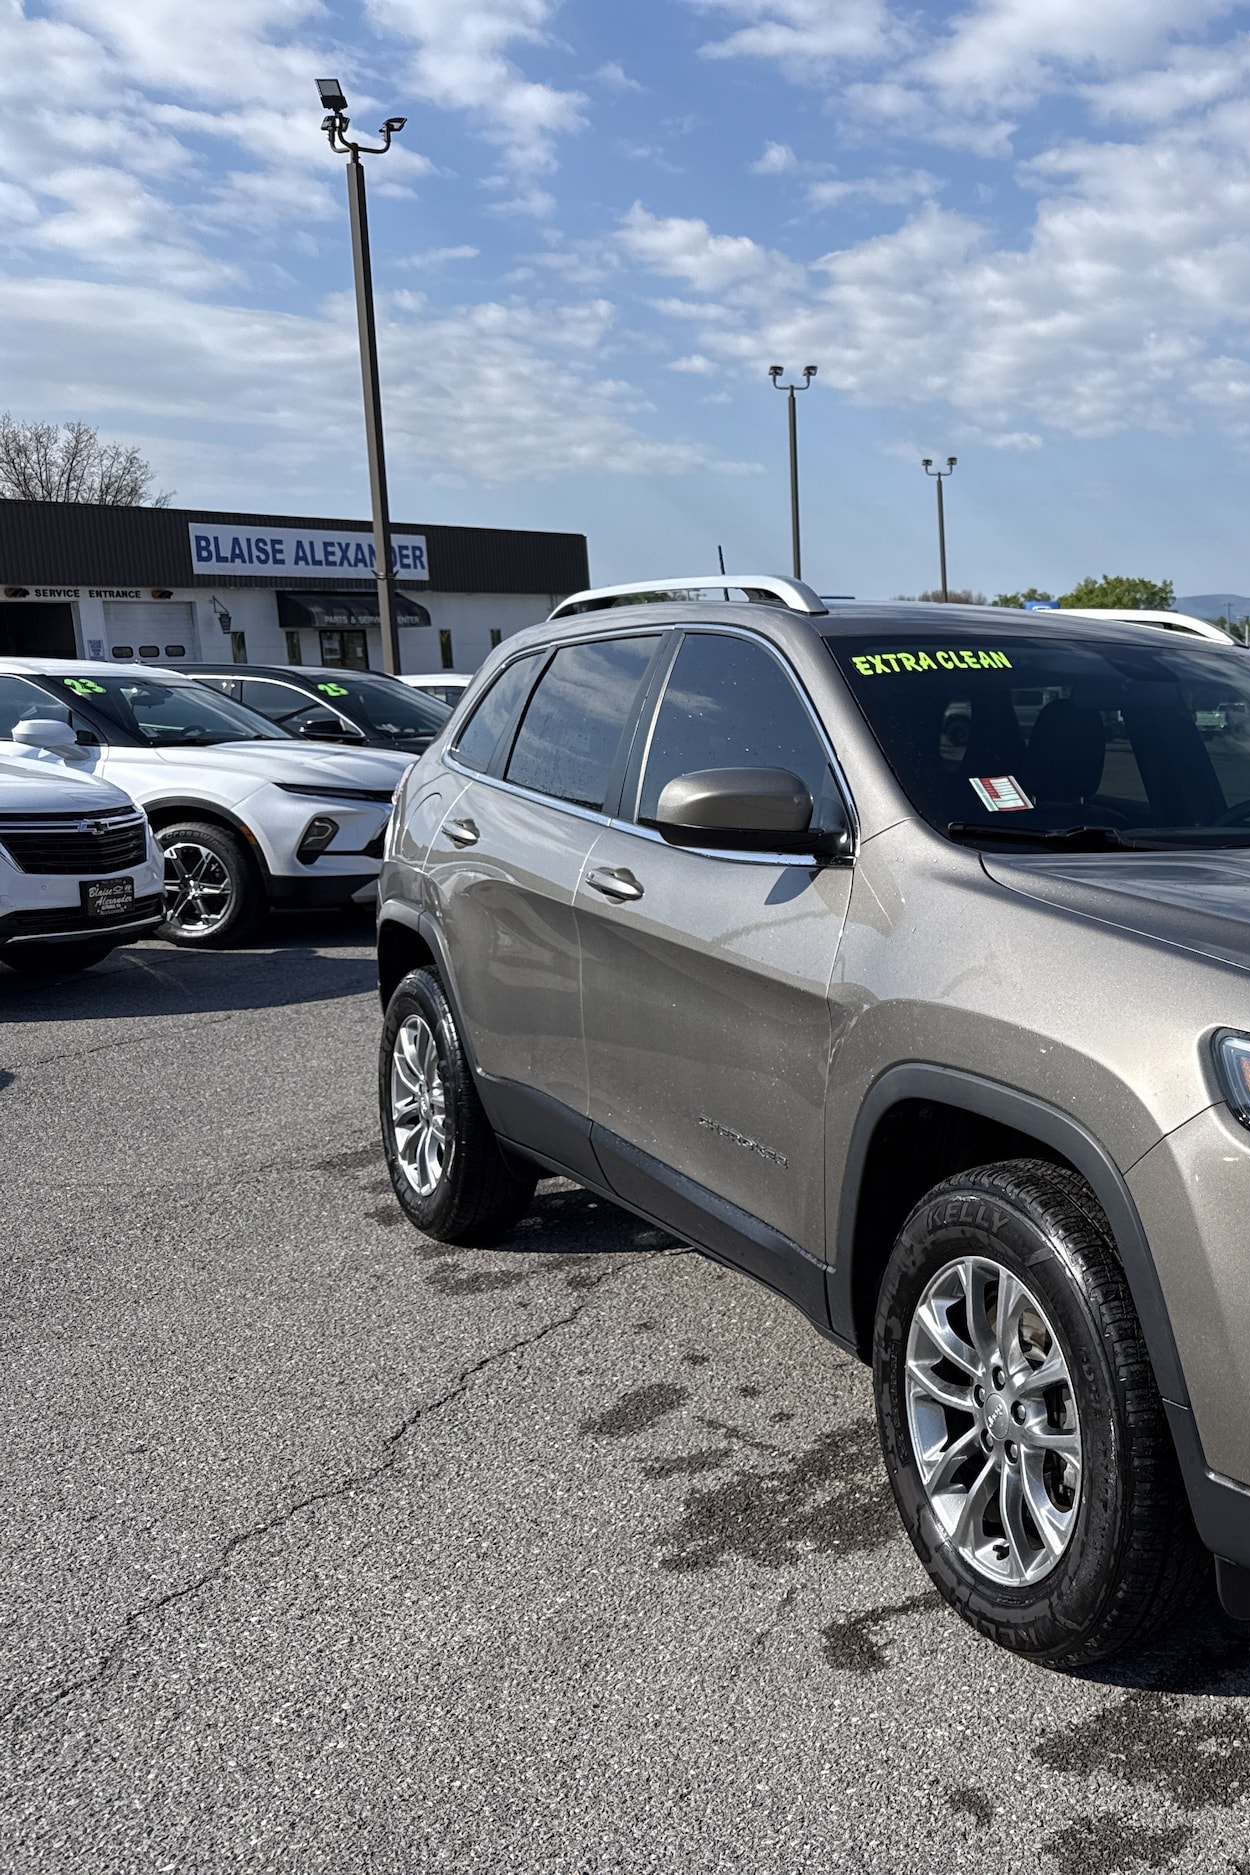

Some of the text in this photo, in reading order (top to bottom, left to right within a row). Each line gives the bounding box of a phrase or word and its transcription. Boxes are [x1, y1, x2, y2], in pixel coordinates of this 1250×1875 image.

[194, 535, 286, 565] BLAISE
[35, 589, 142, 599] SERVICE ENTRANCE
[324, 615, 348, 625] PARTS
[351, 616, 357, 625] &
[396, 615, 420, 625] ENTER
[851, 650, 1013, 676] EXTRA CLEAN
[63, 678, 106, 694] 23
[316, 682, 349, 697] 25
[89, 884, 113, 898] Blaise
[95, 894, 132, 908] Alexander
[926, 1199, 1013, 1234] KELLY
